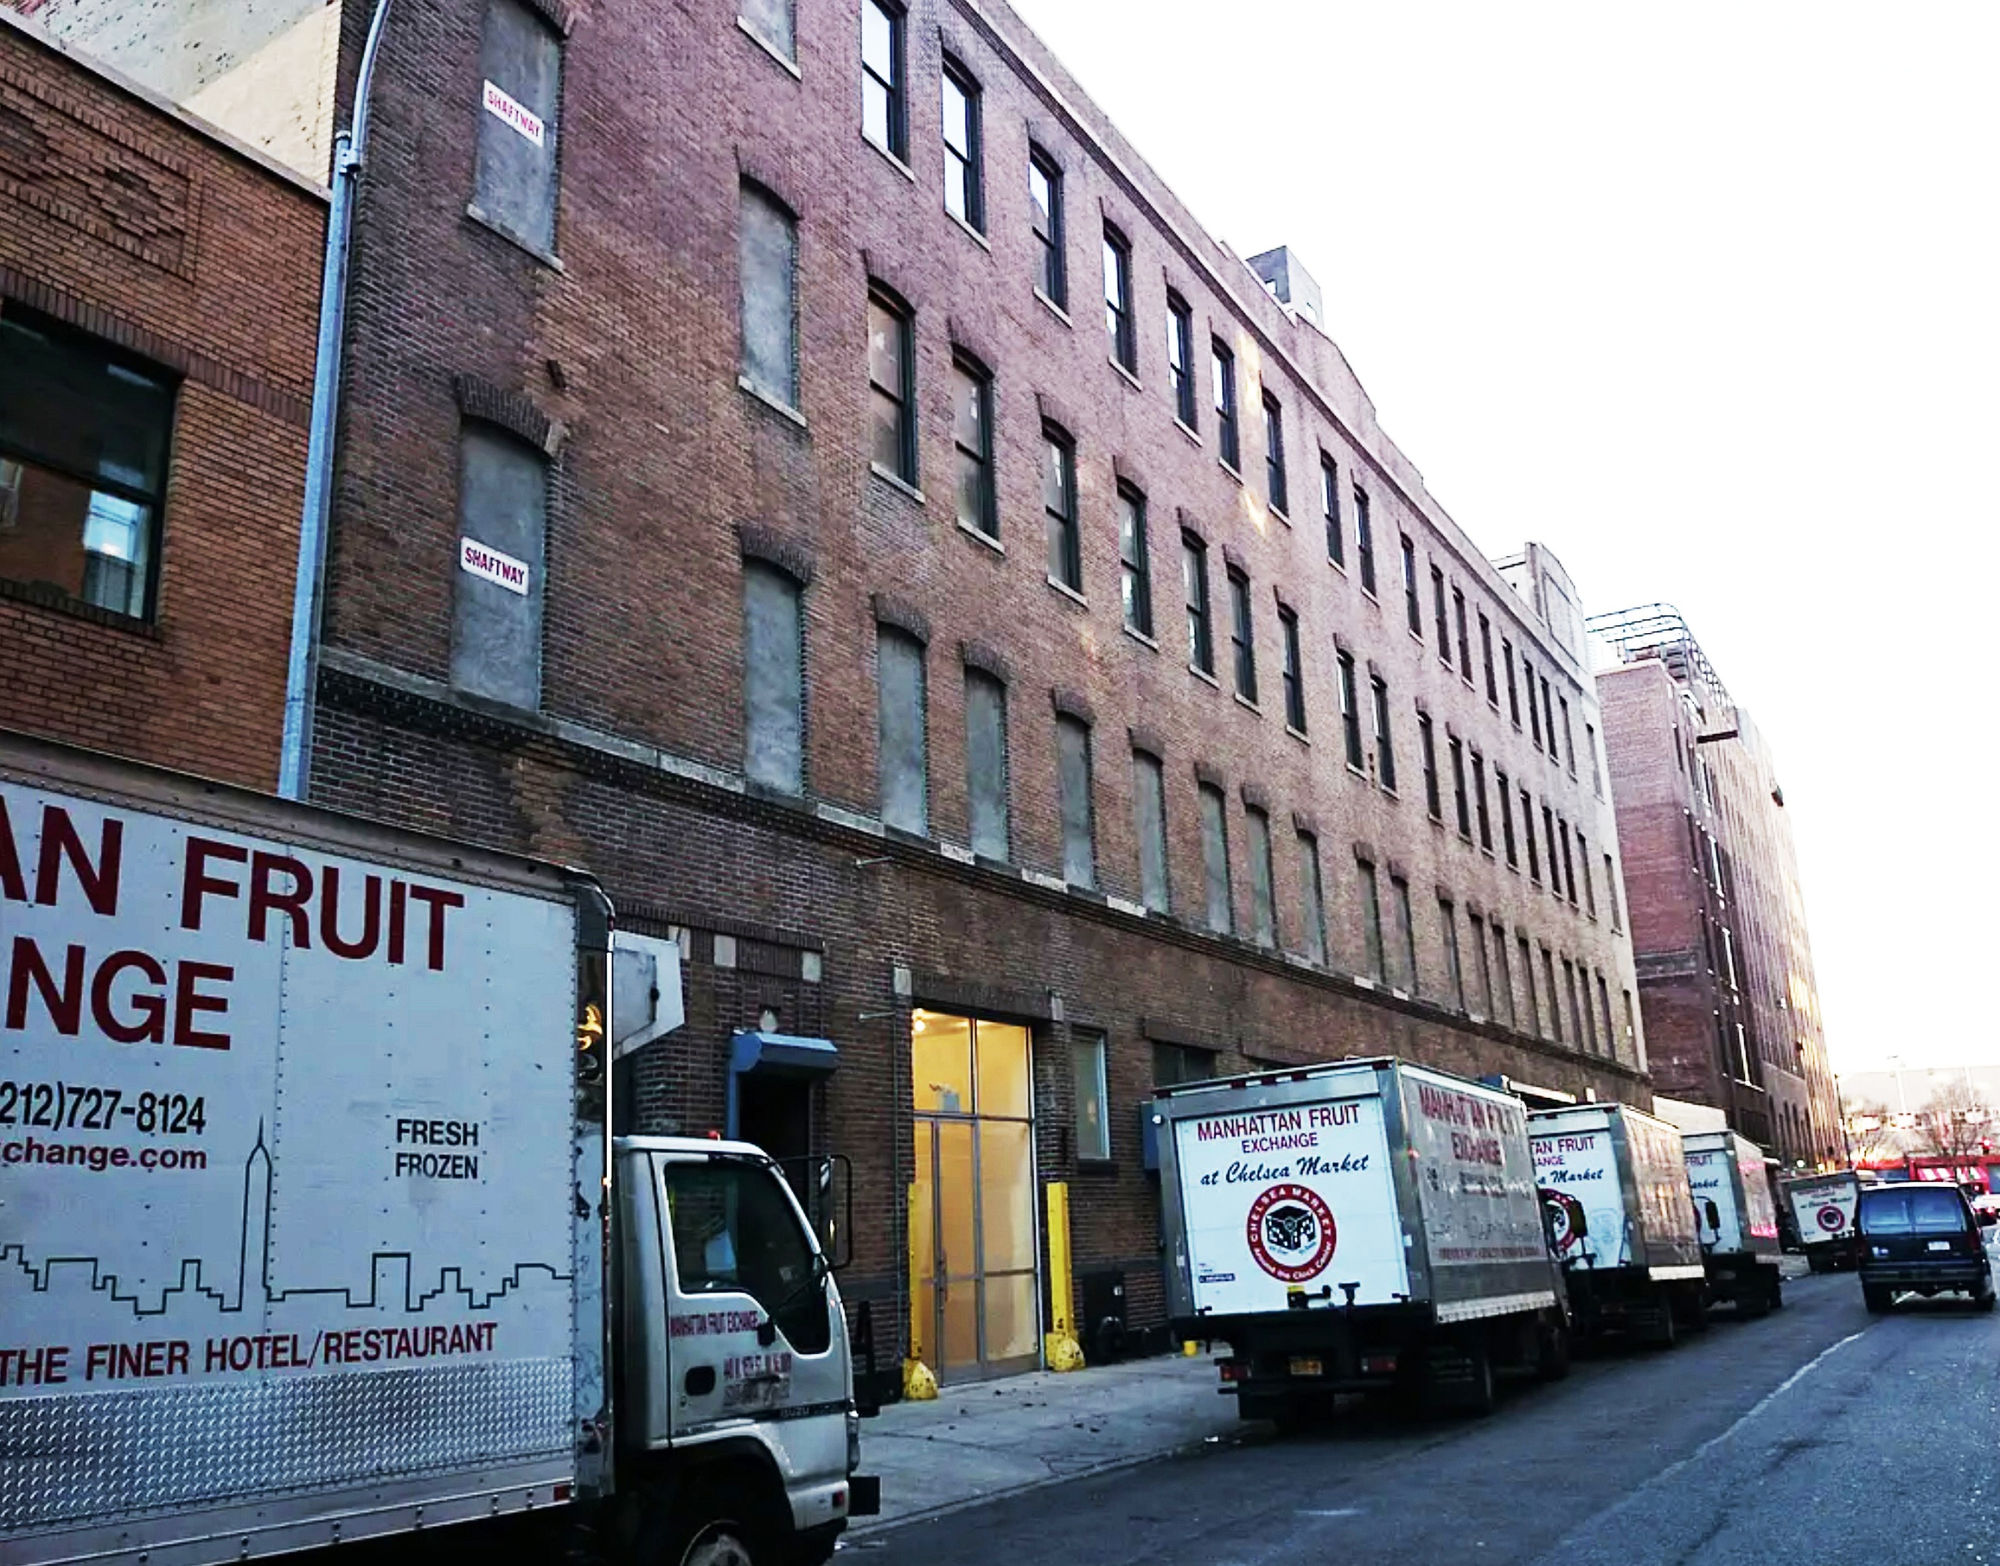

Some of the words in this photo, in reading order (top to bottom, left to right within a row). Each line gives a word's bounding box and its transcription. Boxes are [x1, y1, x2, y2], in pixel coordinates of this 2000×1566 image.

[486, 89, 541, 138] SHAFTWAY
[465, 546, 525, 586] SHAFTWAY
[180, 835, 465, 971] FRUIT
[5, 936, 234, 1051] NGE
[396, 1118, 480, 1147] FRESH
[1197, 1110, 1301, 1142] MANHATTAN
[1309, 1103, 1360, 1128] FRUIT
[1241, 1132, 1319, 1154] EXCHANGE
[1557, 1136, 1595, 1153] FRUIT
[395, 1153, 479, 1180] FROZEN
[1200, 1169, 1219, 1186] at
[1225, 1161, 1291, 1184] Chelsea
[1296, 1154, 1370, 1176] Market
[1550, 1167, 1604, 1183] Market
[1249, 1186, 1287, 1243] CHELSEA
[1292, 1187, 1332, 1236] MARKET
[0, 1347, 69, 1387] THE
[85, 1339, 190, 1381] FINER
[205, 1321, 498, 1373] HOTEL/RESTAURANT
